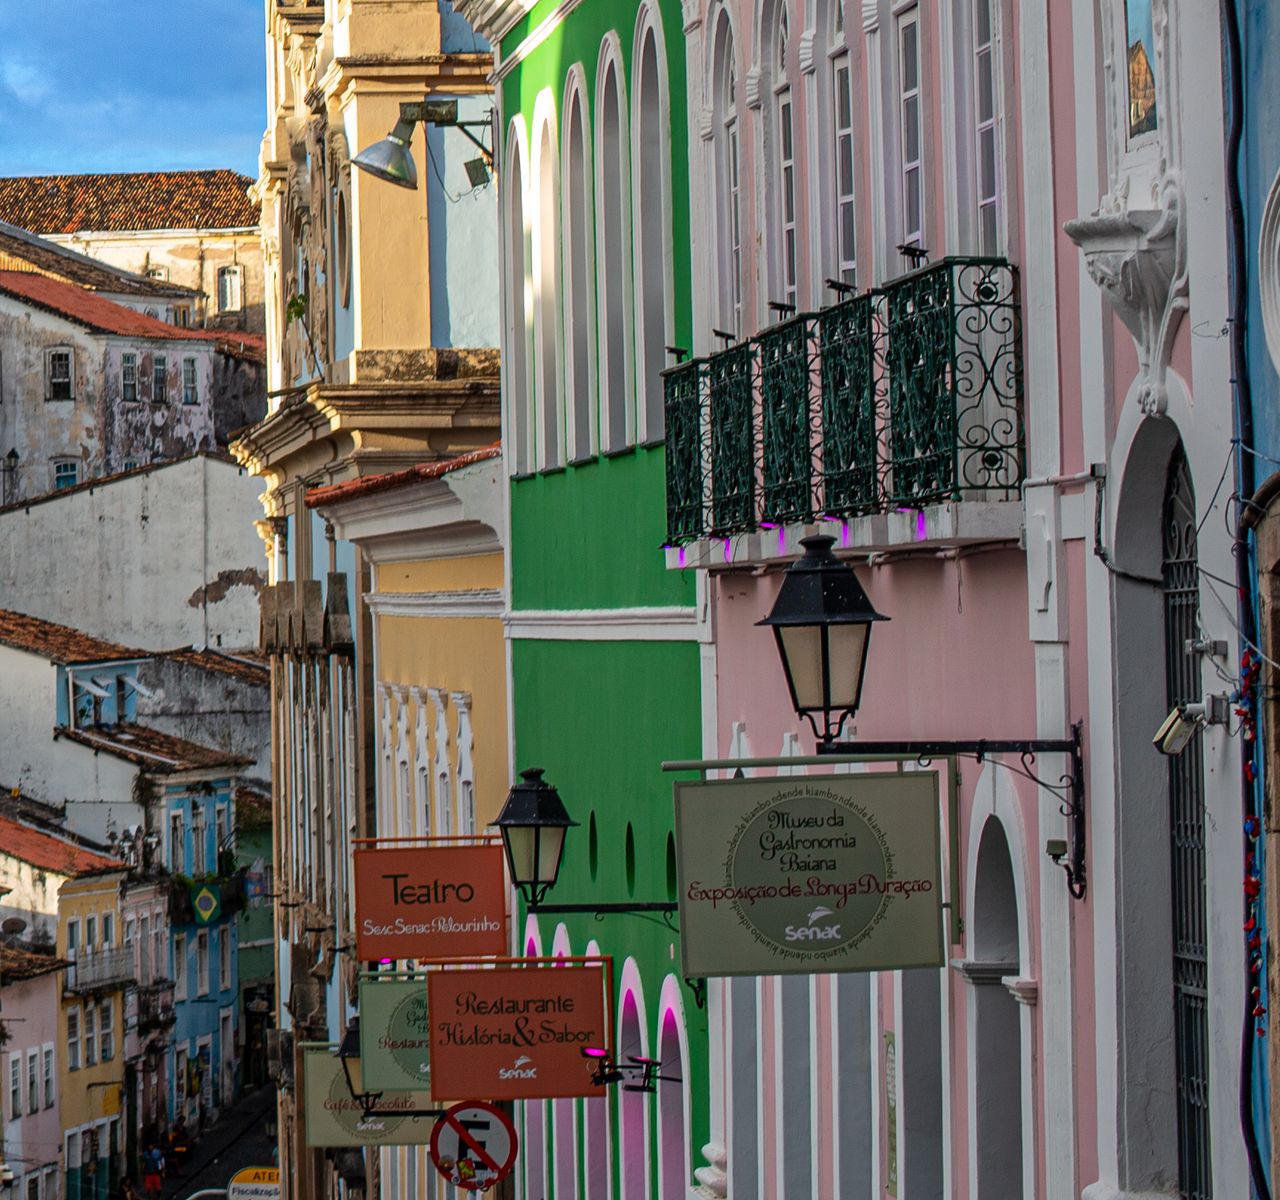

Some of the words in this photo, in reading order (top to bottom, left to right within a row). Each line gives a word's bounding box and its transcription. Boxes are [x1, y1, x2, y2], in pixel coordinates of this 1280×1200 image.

[768, 810, 824, 829] Museu
[826, 808, 844, 827] da
[770, 787, 803, 803] ndende
[806, 787, 840, 800] kiambo
[839, 793, 871, 818] ndende
[866, 814, 891, 846] kiambo
[760, 830, 856, 860] Gastronomia
[780, 852, 836, 872] Baiana
[382, 874, 474, 905] Teatro
[688, 881, 777, 908] Exposição
[779, 877, 802, 897] de
[804, 876, 857, 909] Longa
[858, 874, 932, 898] Duração
[363, 919, 393, 935] Sesc
[394, 918, 430, 934] Senac
[431, 914, 500, 932] Pelourinho
[456, 991, 575, 1015] Restaurante
[439, 1022, 513, 1046] História
[512, 1016, 537, 1047] &
[538, 1020, 594, 1043] Sabor
